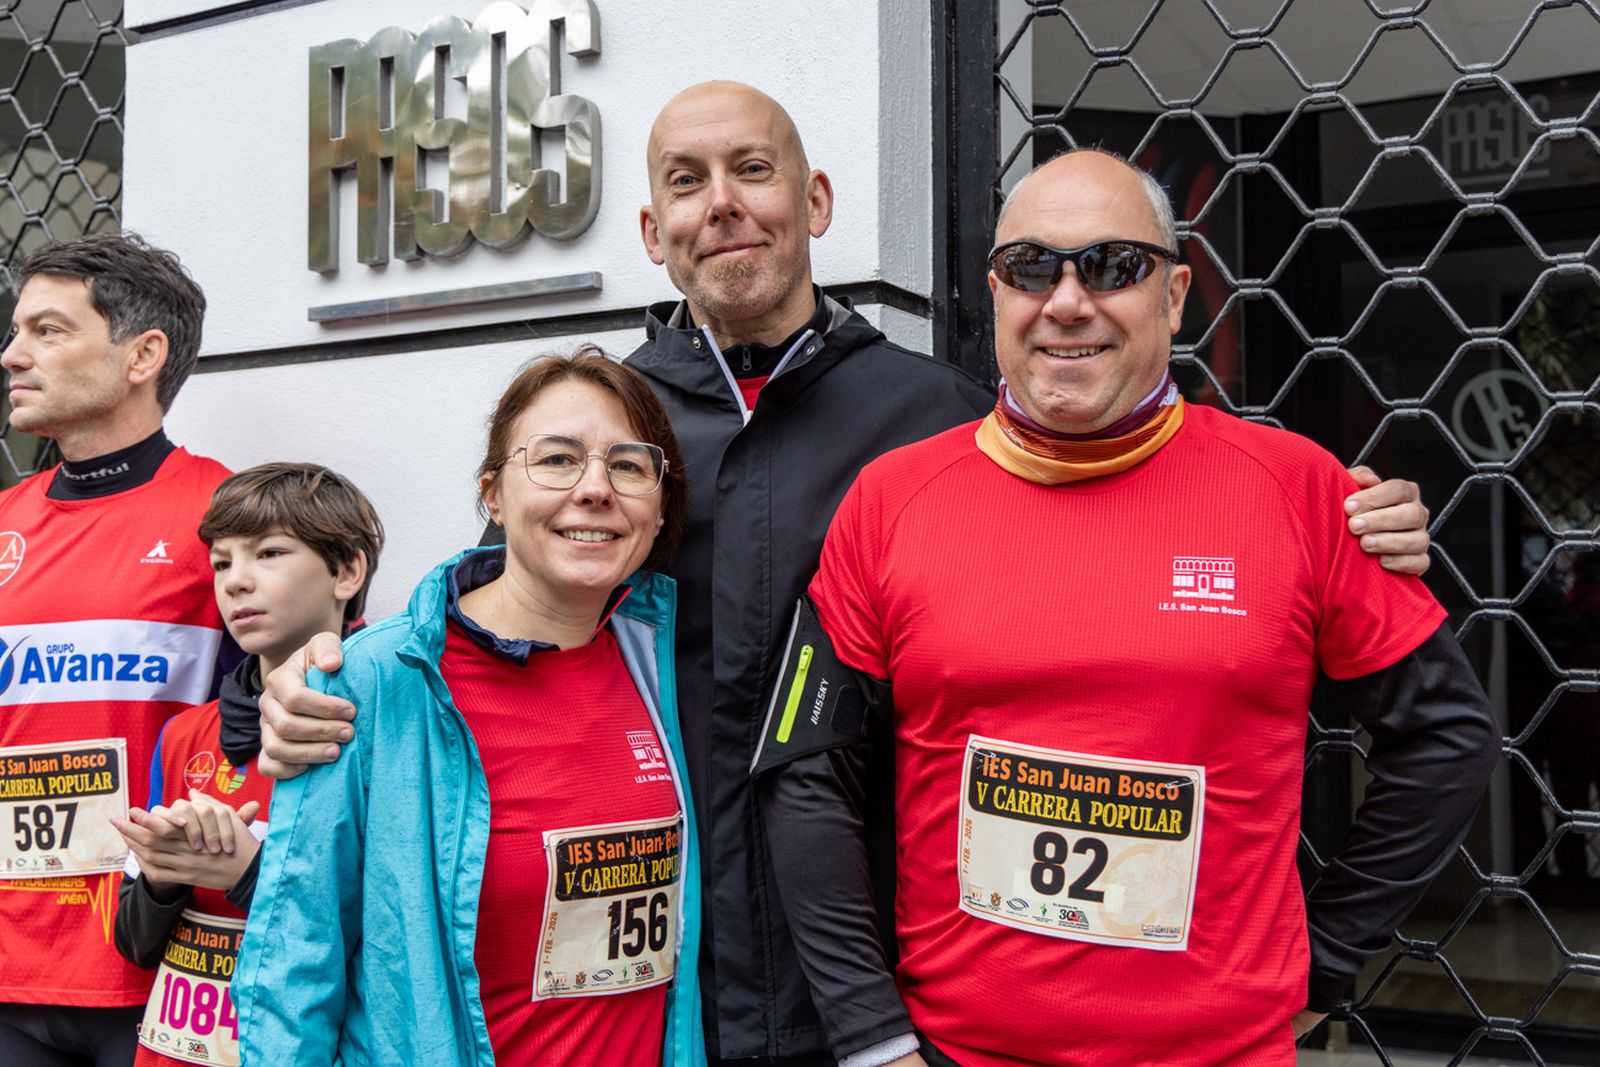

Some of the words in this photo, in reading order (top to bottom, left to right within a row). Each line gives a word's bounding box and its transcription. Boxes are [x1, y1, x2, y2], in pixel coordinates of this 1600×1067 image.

[1180, 603, 1197, 611] San
[1199, 604, 1219, 613] Juan
[1221, 606, 1247, 617] Bosco
[46, 643, 75, 654] GRUPO
[19, 647, 169, 685] Avanza
[8, 758, 26, 776] San
[28, 757, 59, 774] Juan
[62, 753, 107, 771] Bosco
[48, 771, 114, 795] POPULAR
[982, 757, 1011, 780] IES
[1018, 761, 1053, 787] San
[1060, 768, 1110, 795] Juan
[1118, 775, 1179, 801] Bosco
[976, 781, 988, 806] V
[993, 786, 1081, 823] CARRERA
[1089, 801, 1182, 834] POPULAR
[14, 802, 78, 851] 587
[964, 818, 973, 840] 2026
[568, 841, 593, 865] IES
[597, 838, 625, 862] San
[629, 835, 662, 857] Juan
[564, 871, 576, 894] V
[581, 862, 647, 893] CARRERA
[1030, 831, 1109, 903] 82
[56, 892, 88, 905] JAÉN
[548, 912, 558, 931] 2026
[607, 892, 668, 960] 156
[194, 927, 230, 949] Juan
[211, 953, 237, 976] PO
[159, 972, 239, 1041] 1084
